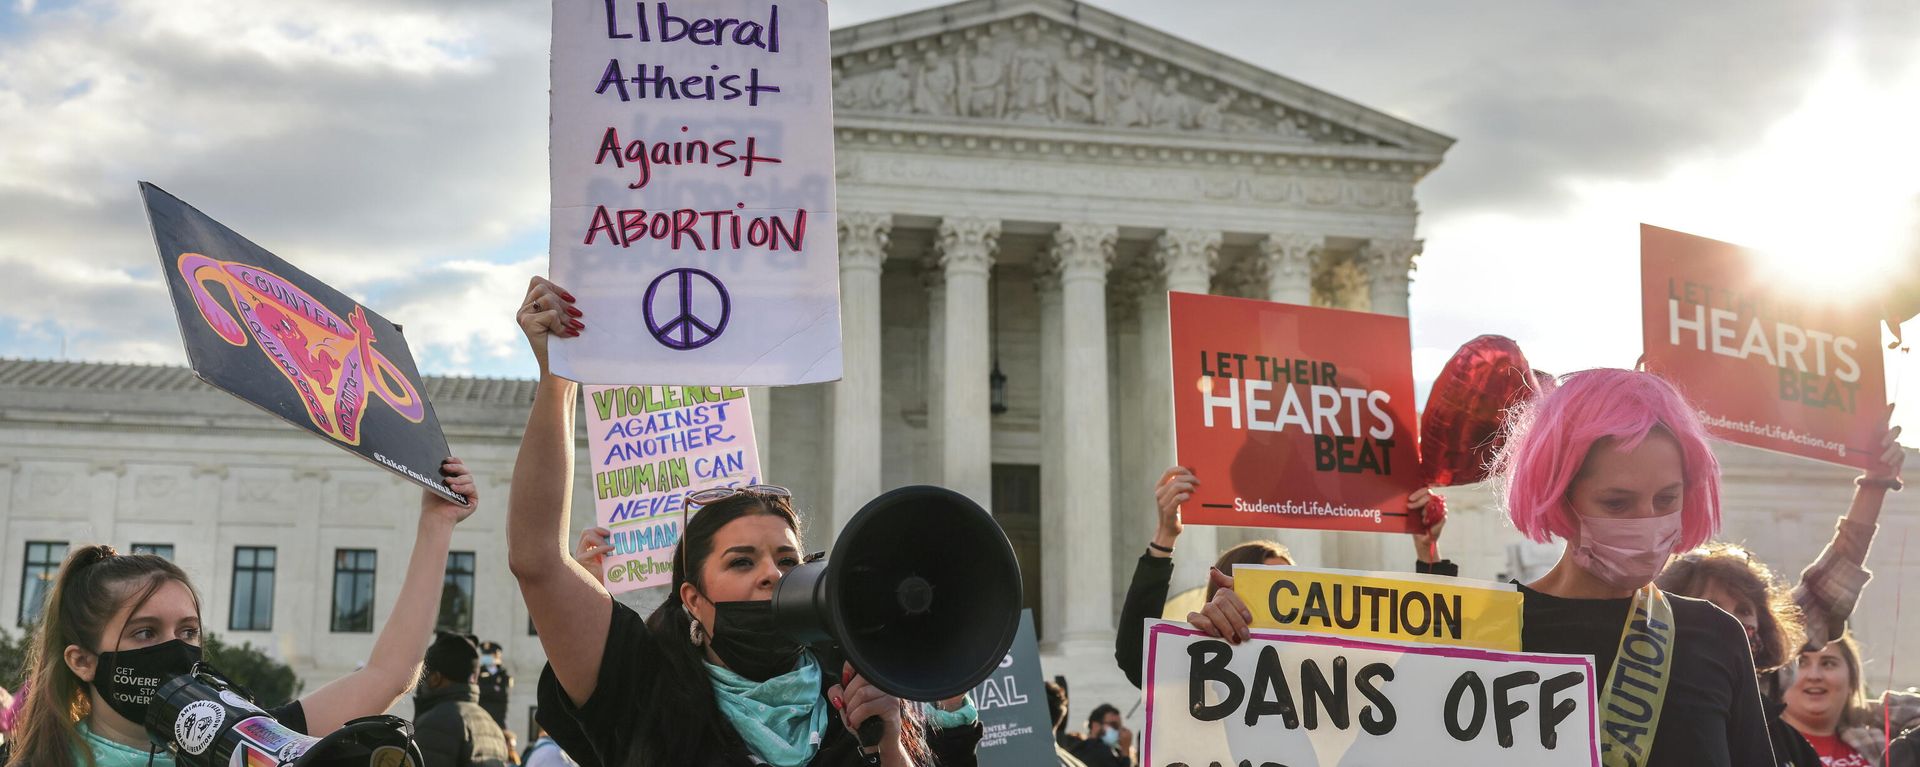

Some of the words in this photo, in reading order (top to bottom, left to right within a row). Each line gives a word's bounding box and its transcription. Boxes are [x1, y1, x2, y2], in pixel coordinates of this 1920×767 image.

[595, 58, 780, 106] Atheist
[595, 126, 782, 189] Against
[241, 270, 339, 334] COUNTER
[1669, 277, 1713, 307] LET
[1669, 299, 1861, 383] HEARTS
[240, 300, 327, 425] PREBORN
[1201, 350, 1247, 379] LET
[1255, 355, 1338, 387] THEIR
[1202, 375, 1394, 440] HEARTS
[1778, 366, 1861, 416] BEAT
[604, 402, 730, 441] AGAINST
[1697, 410, 1846, 457] StudentsforLifeAction.org
[604, 424, 736, 465] ANOTHER
[1314, 434, 1395, 476] BEAT
[596, 457, 690, 500] HUMAN
[694, 450, 744, 478] CAN
[1234, 497, 1382, 524] StudentsforLifeAction.org
[604, 520, 678, 556] HUMAN
[1268, 579, 1462, 639] CAUTION
[113, 674, 161, 687] COVERE
[116, 666, 134, 676] GET
[140, 687, 156, 696] STA
[113, 693, 153, 705] COVER
[1187, 640, 1397, 736] BANS
[1444, 670, 1585, 750] OFF
[983, 726, 1033, 740] EPRODUCTIVE
[984, 724, 1006, 733] ENTER
